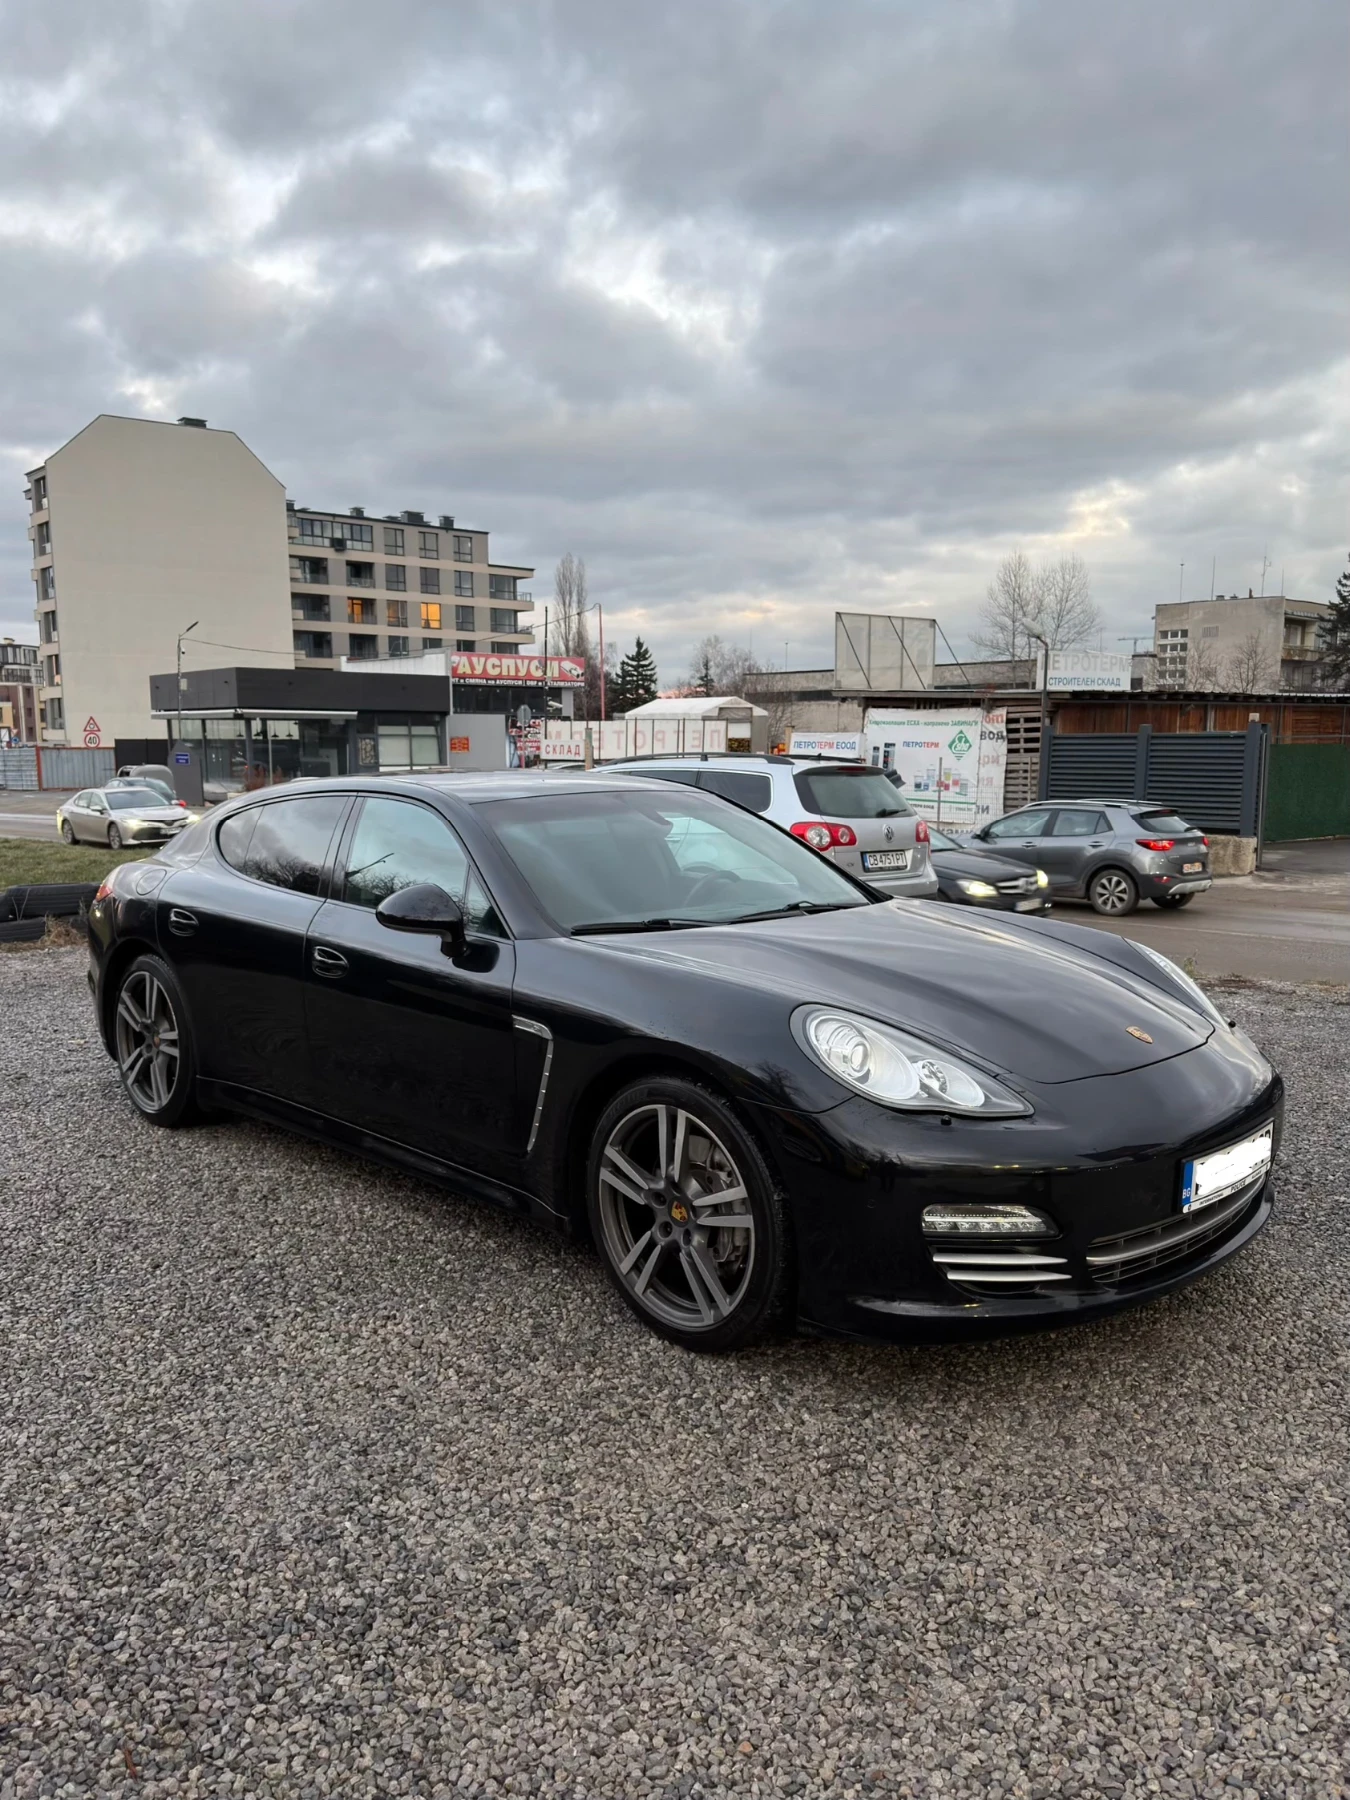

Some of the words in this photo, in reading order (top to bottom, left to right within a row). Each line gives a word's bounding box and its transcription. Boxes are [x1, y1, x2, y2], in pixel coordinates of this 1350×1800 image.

[457, 655, 560, 678] АУСПУСИ
[1048, 676, 1095, 686] СТРОИТЕЛЕН
[1096, 677, 1121, 687] СКЛАД
[87, 736, 97, 745] 40
[793, 740, 835, 750] ПЕТРОТЕРМ
[835, 741, 857, 750] ЕООД
[903, 741, 940, 749] ПЕТРОТЕРМ
[545, 744, 581, 757] СКЛАД
[1231, 1180, 1246, 1192] POLICE
[1182, 1187, 1191, 1199] BG
